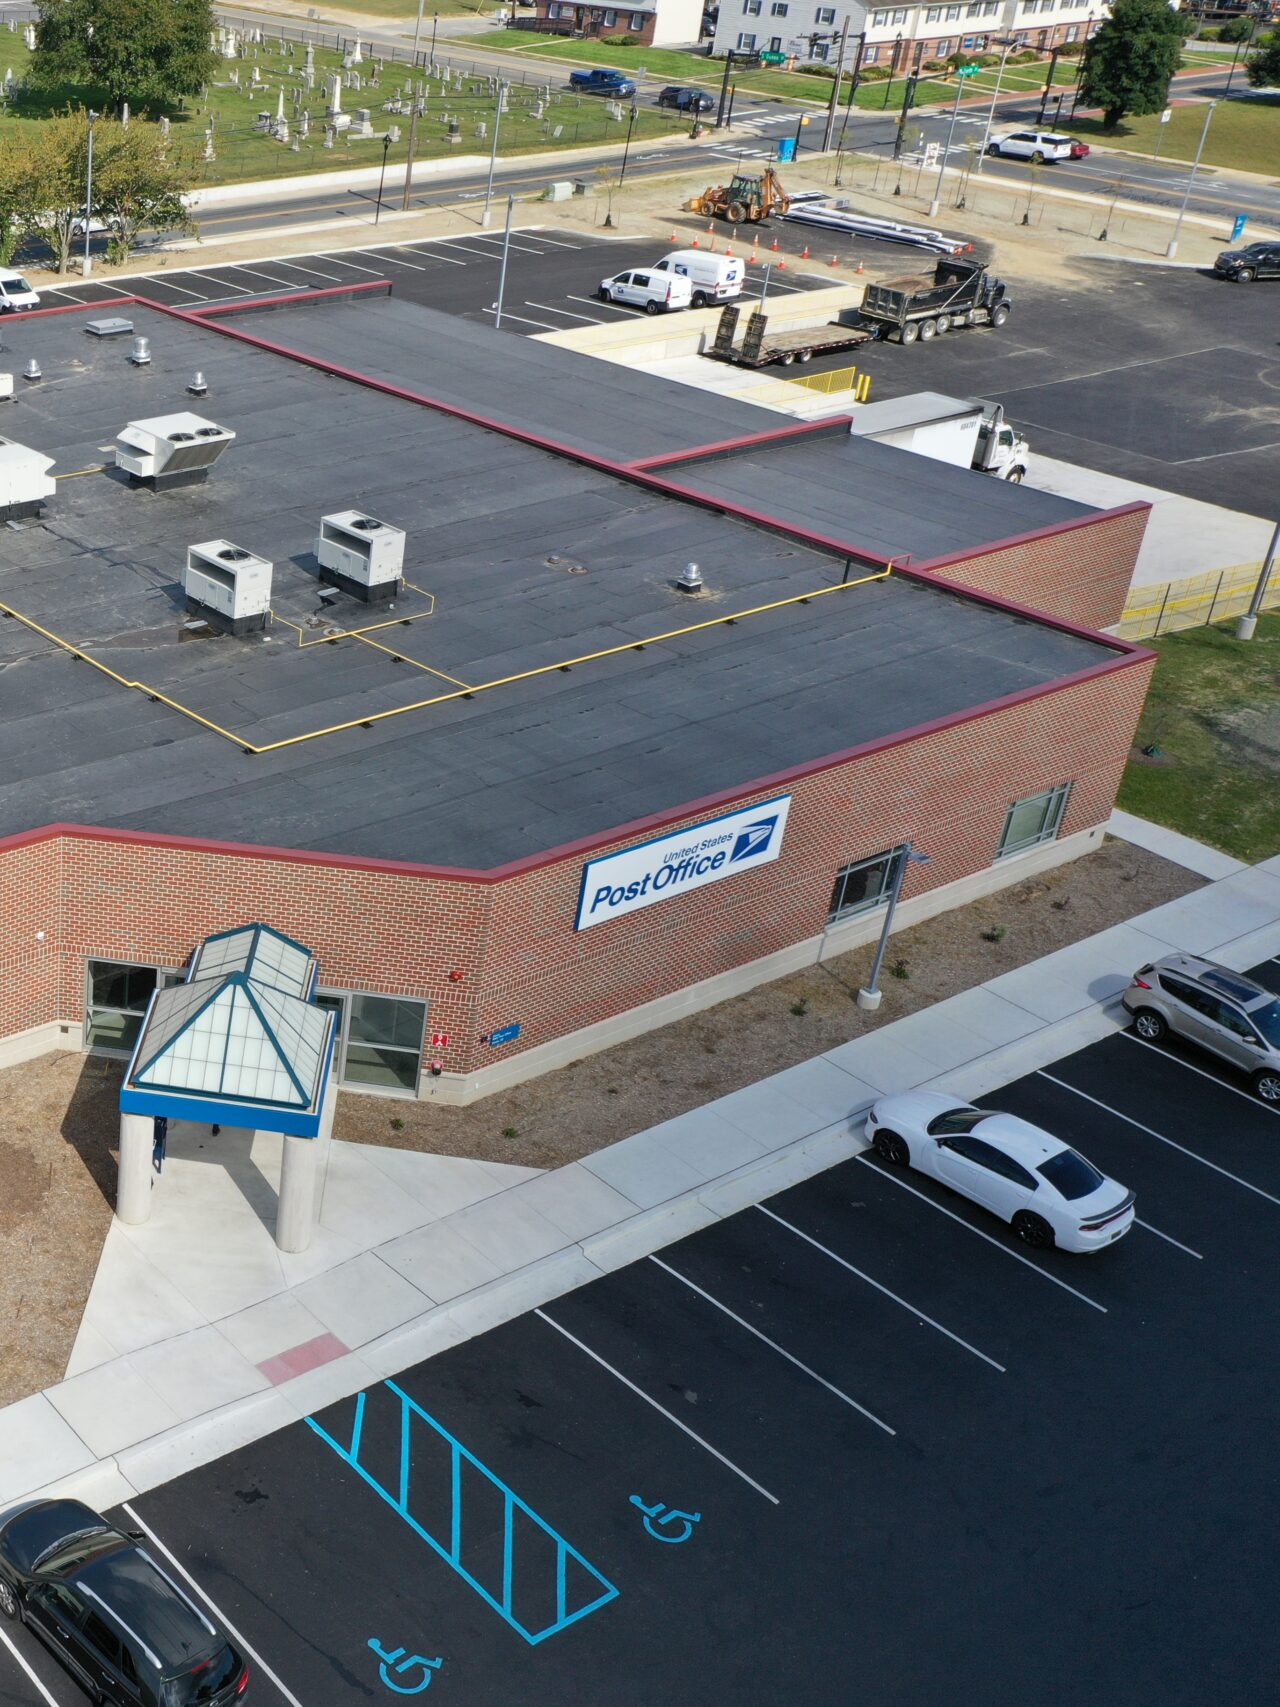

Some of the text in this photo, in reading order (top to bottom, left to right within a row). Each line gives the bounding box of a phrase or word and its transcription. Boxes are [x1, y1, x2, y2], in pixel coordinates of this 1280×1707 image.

[663, 832, 733, 863] United States
[590, 851, 726, 913] Post Office
